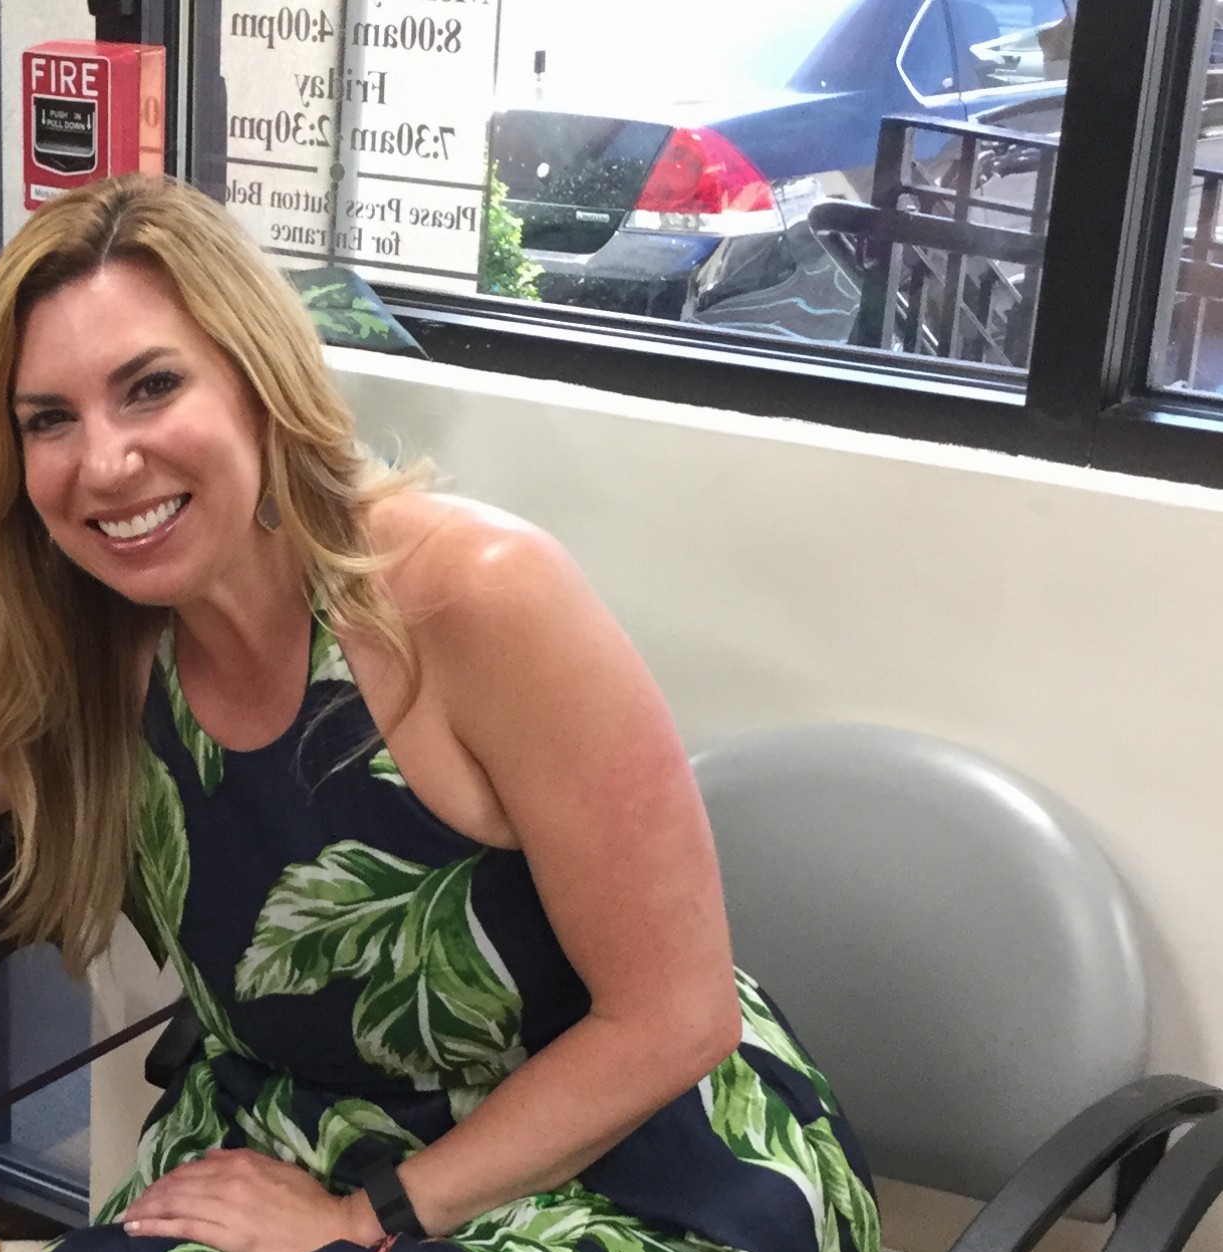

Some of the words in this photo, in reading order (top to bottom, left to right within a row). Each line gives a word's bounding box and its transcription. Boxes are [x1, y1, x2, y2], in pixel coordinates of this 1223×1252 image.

[31, 57, 99, 96] FIRE
[49, 109, 68, 119] PUSH
[73, 112, 82, 120] IN
[46, 119, 63, 129] PULL
[64, 120, 86, 131] DOWN
